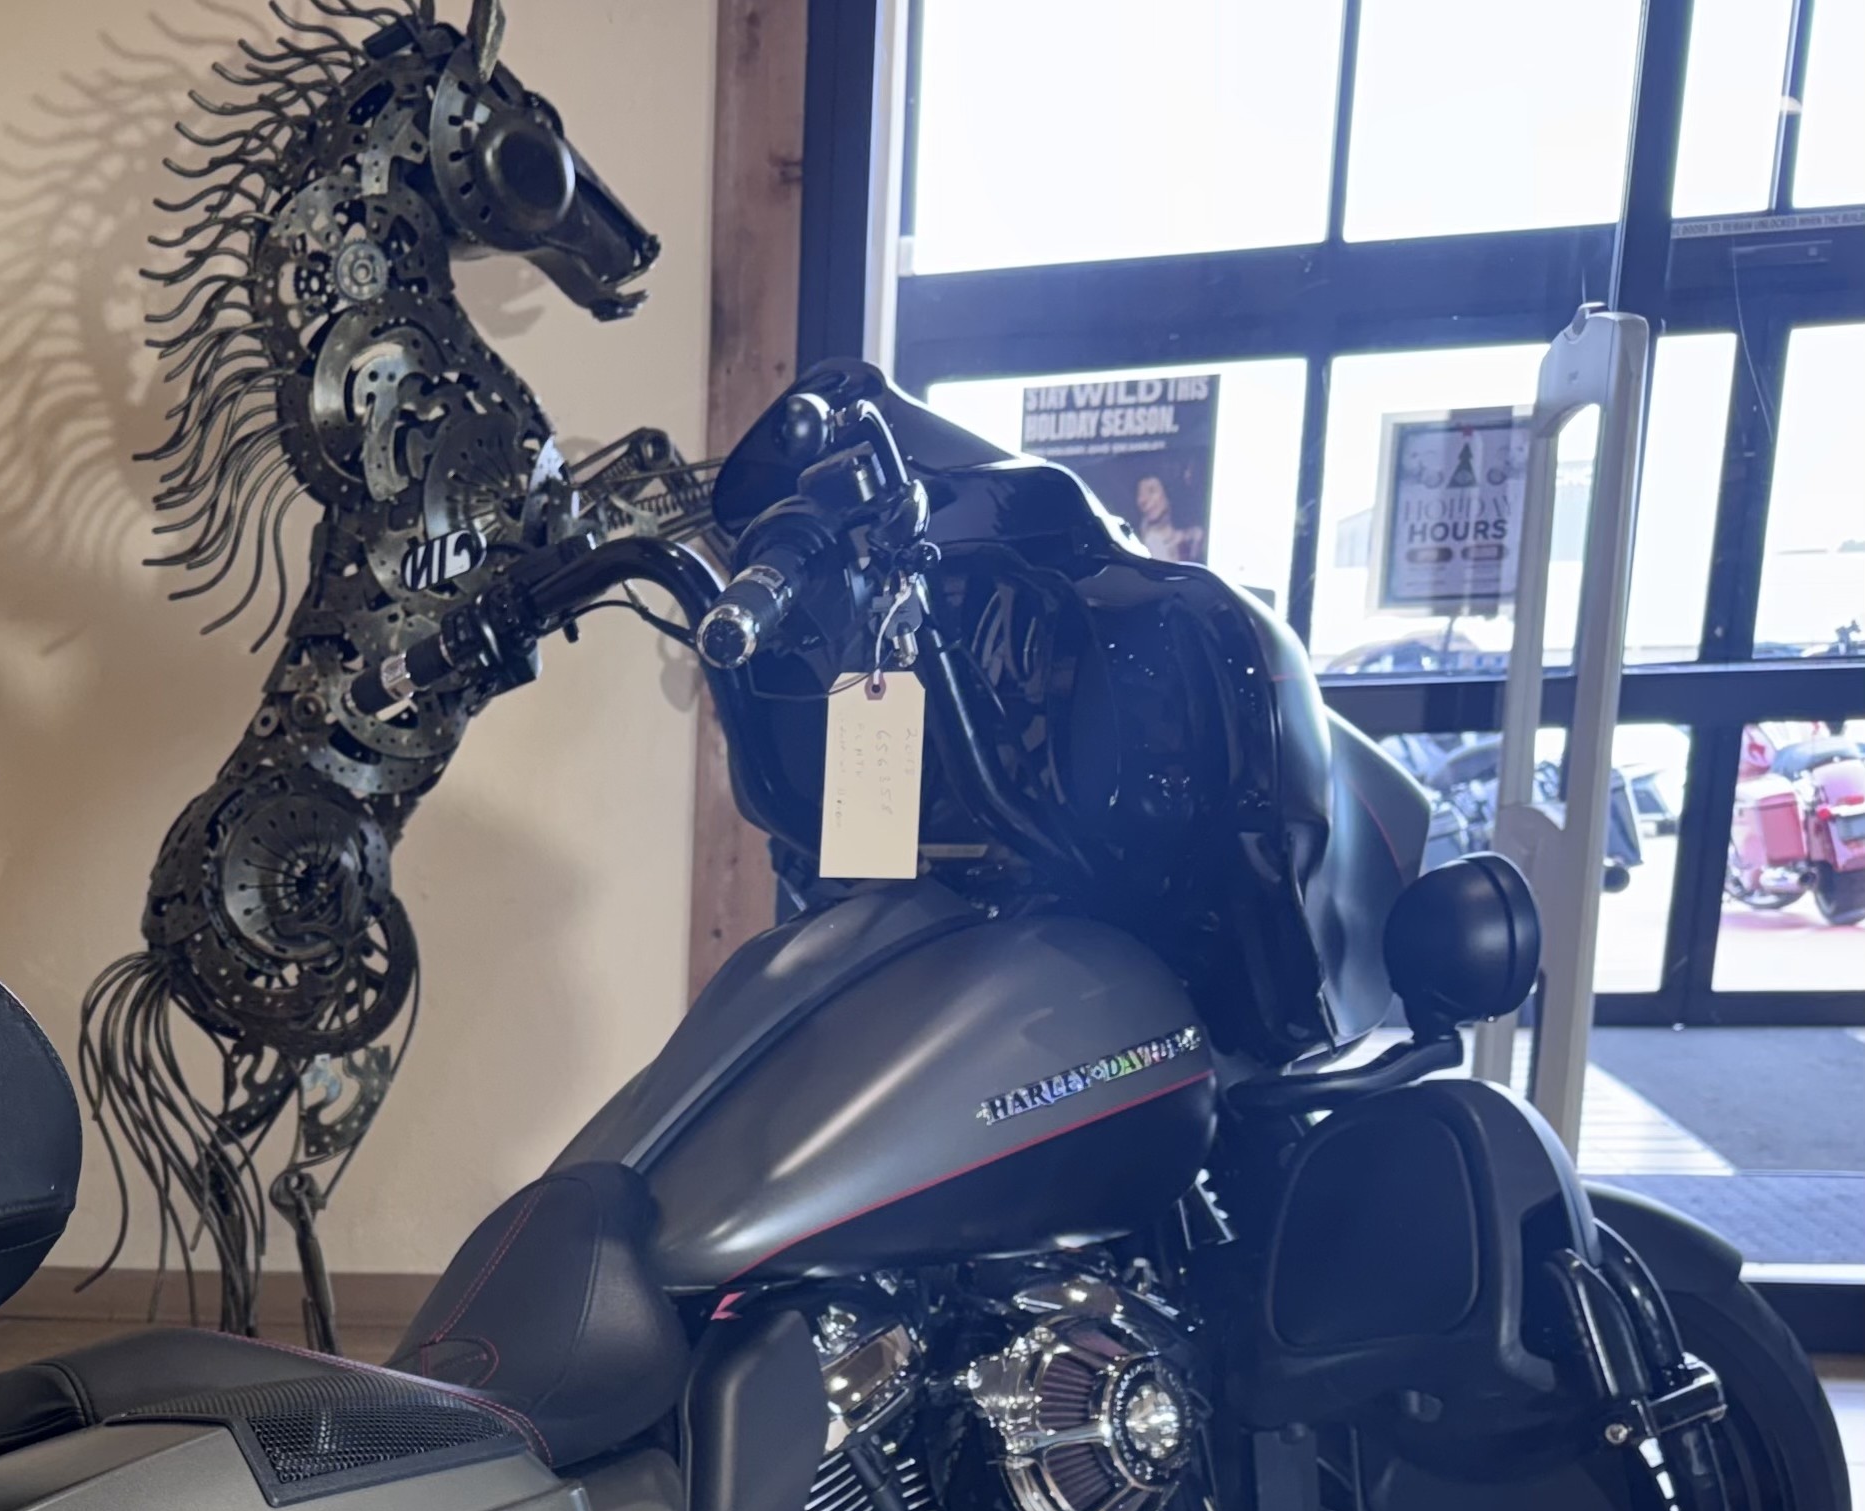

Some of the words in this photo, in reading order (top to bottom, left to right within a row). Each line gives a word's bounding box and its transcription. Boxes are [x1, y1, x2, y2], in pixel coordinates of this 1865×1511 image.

[1024, 386, 1069, 411] STAY
[1072, 379, 1164, 408] WILD
[1166, 376, 1209, 401] THIS
[1024, 410, 1100, 442] HOLIDAY
[1100, 405, 1180, 438] SEASON.
[1407, 519, 1508, 544] HOURS
